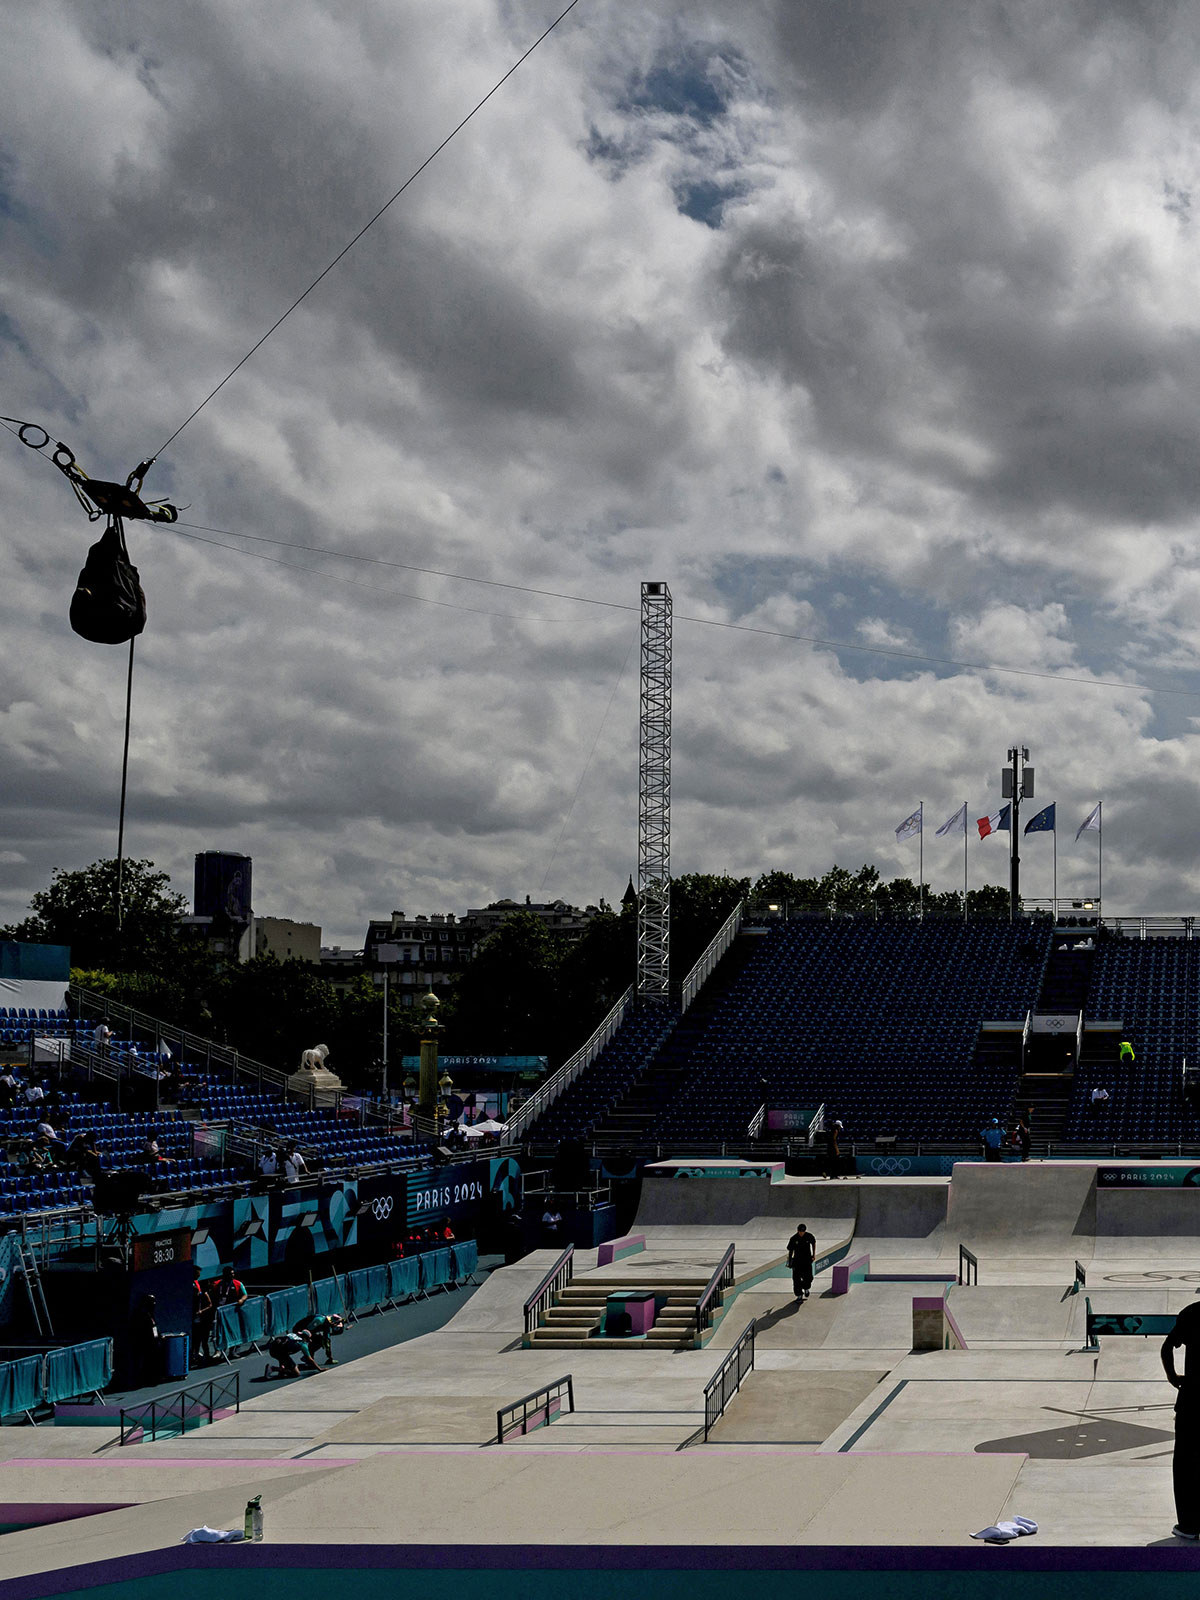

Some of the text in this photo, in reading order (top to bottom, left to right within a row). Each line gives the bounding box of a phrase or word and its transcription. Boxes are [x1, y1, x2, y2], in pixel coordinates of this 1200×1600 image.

[1120, 1173, 1175, 1181] PARIS 2024
[453, 1180, 483, 1204] 2024
[153, 1247, 174, 1264] 38:30
